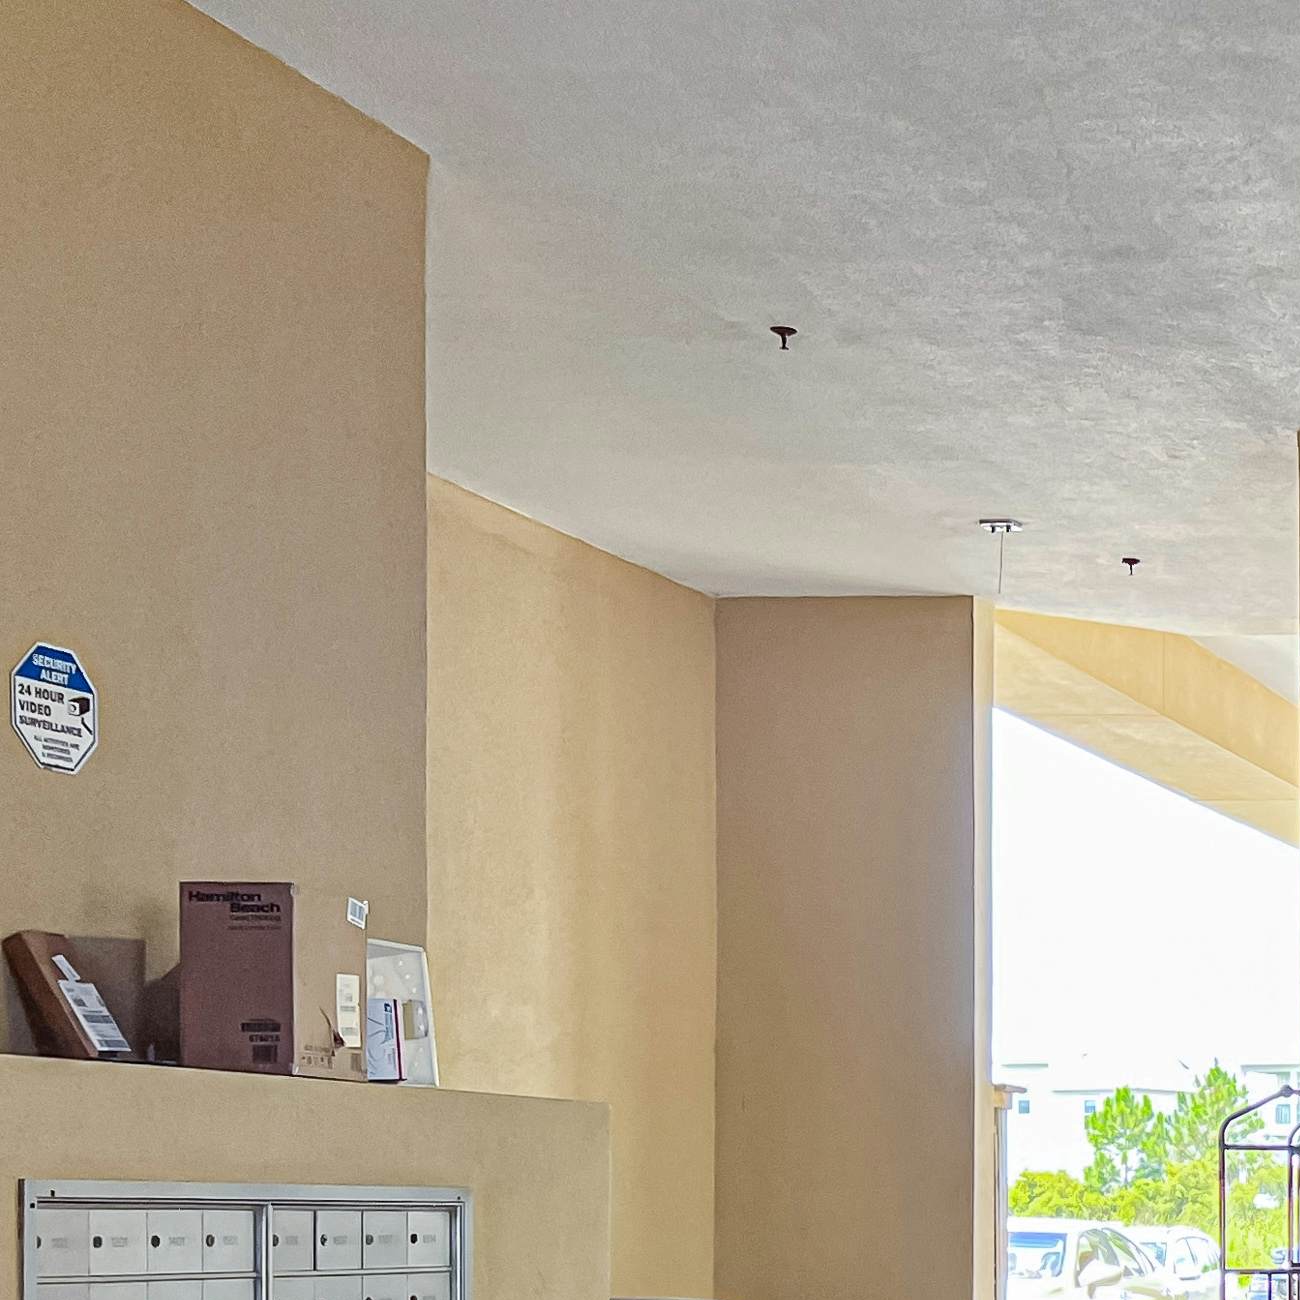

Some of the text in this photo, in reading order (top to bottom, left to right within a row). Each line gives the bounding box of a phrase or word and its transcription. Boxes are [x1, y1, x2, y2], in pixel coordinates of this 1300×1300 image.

[32, 653, 77, 674] SECURITY
[40, 669, 69, 685] ALERT
[18, 683, 65, 704] 24 HOUR
[18, 698, 52, 717] VIDEO
[18, 714, 83, 737] SURVEILLANCE
[188, 890, 261, 902] Hamilton
[230, 902, 280, 913] Beach
